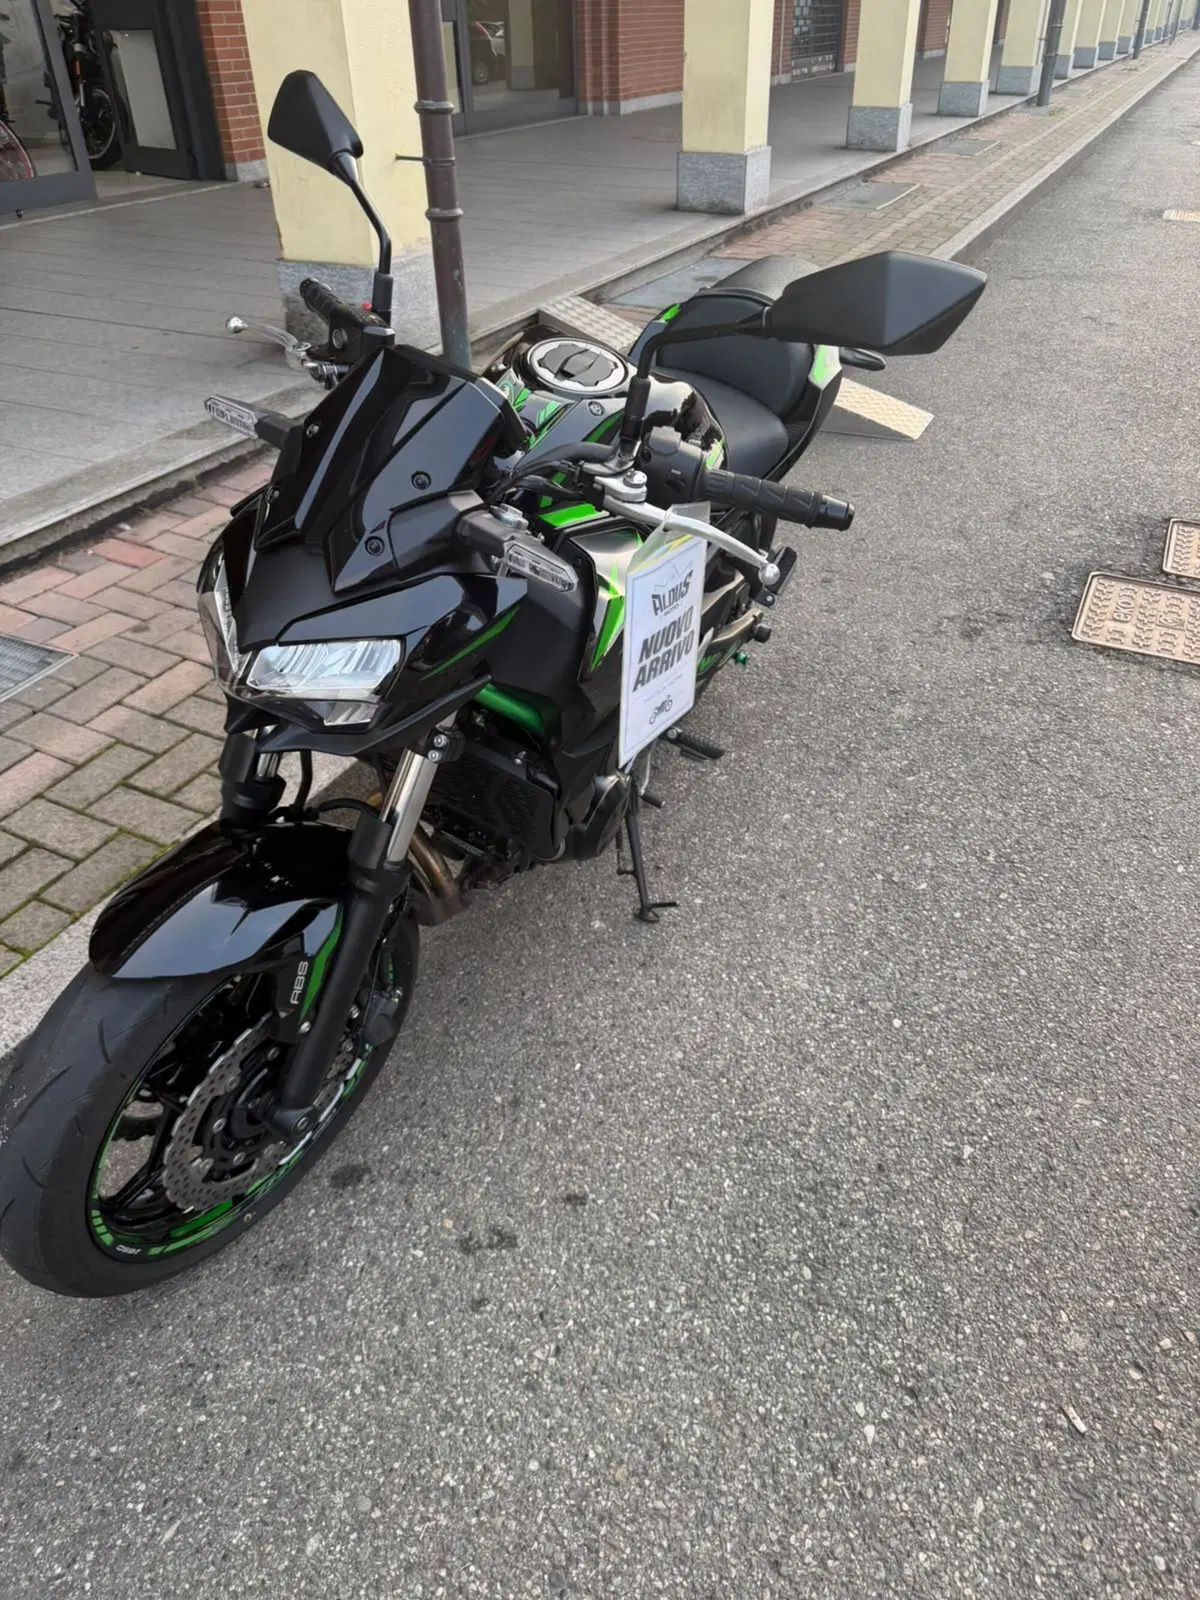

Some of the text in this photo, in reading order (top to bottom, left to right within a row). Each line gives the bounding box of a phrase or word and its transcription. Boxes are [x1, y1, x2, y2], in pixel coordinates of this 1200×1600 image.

[651, 569, 694, 616] ALDUS
[632, 629, 695, 693] ARRIVO
[638, 605, 693, 664] NUOVO
[290, 961, 309, 1004] ABS
